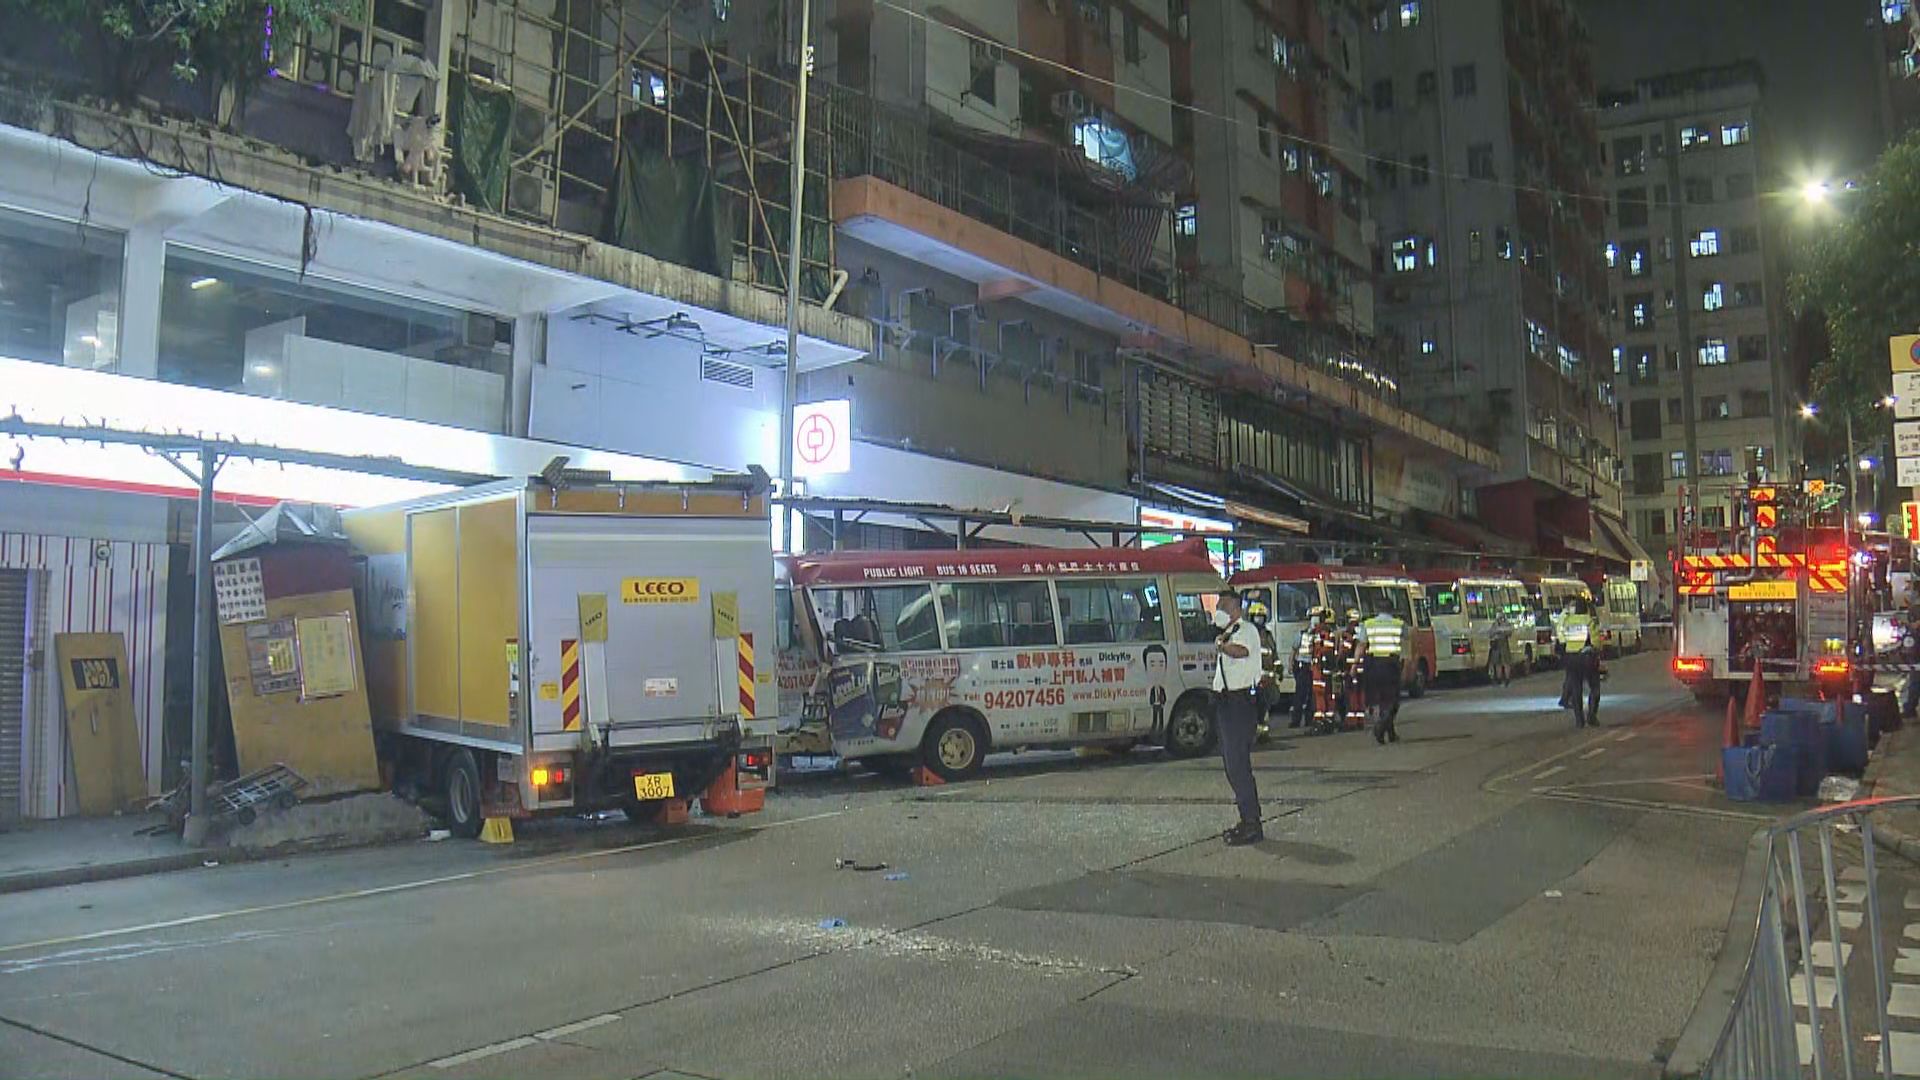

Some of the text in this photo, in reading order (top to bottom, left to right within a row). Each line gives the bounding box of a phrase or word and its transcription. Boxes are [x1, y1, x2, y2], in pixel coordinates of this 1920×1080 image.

[863, 567, 897, 578] PUBLIC
[898, 566, 925, 577] LIGHT
[936, 565, 956, 576] BUS
[969, 563, 998, 575] SEATS
[984, 688, 1065, 709] 94207456
[646, 775, 661, 787] XR
[640, 785, 670, 799] 3007
